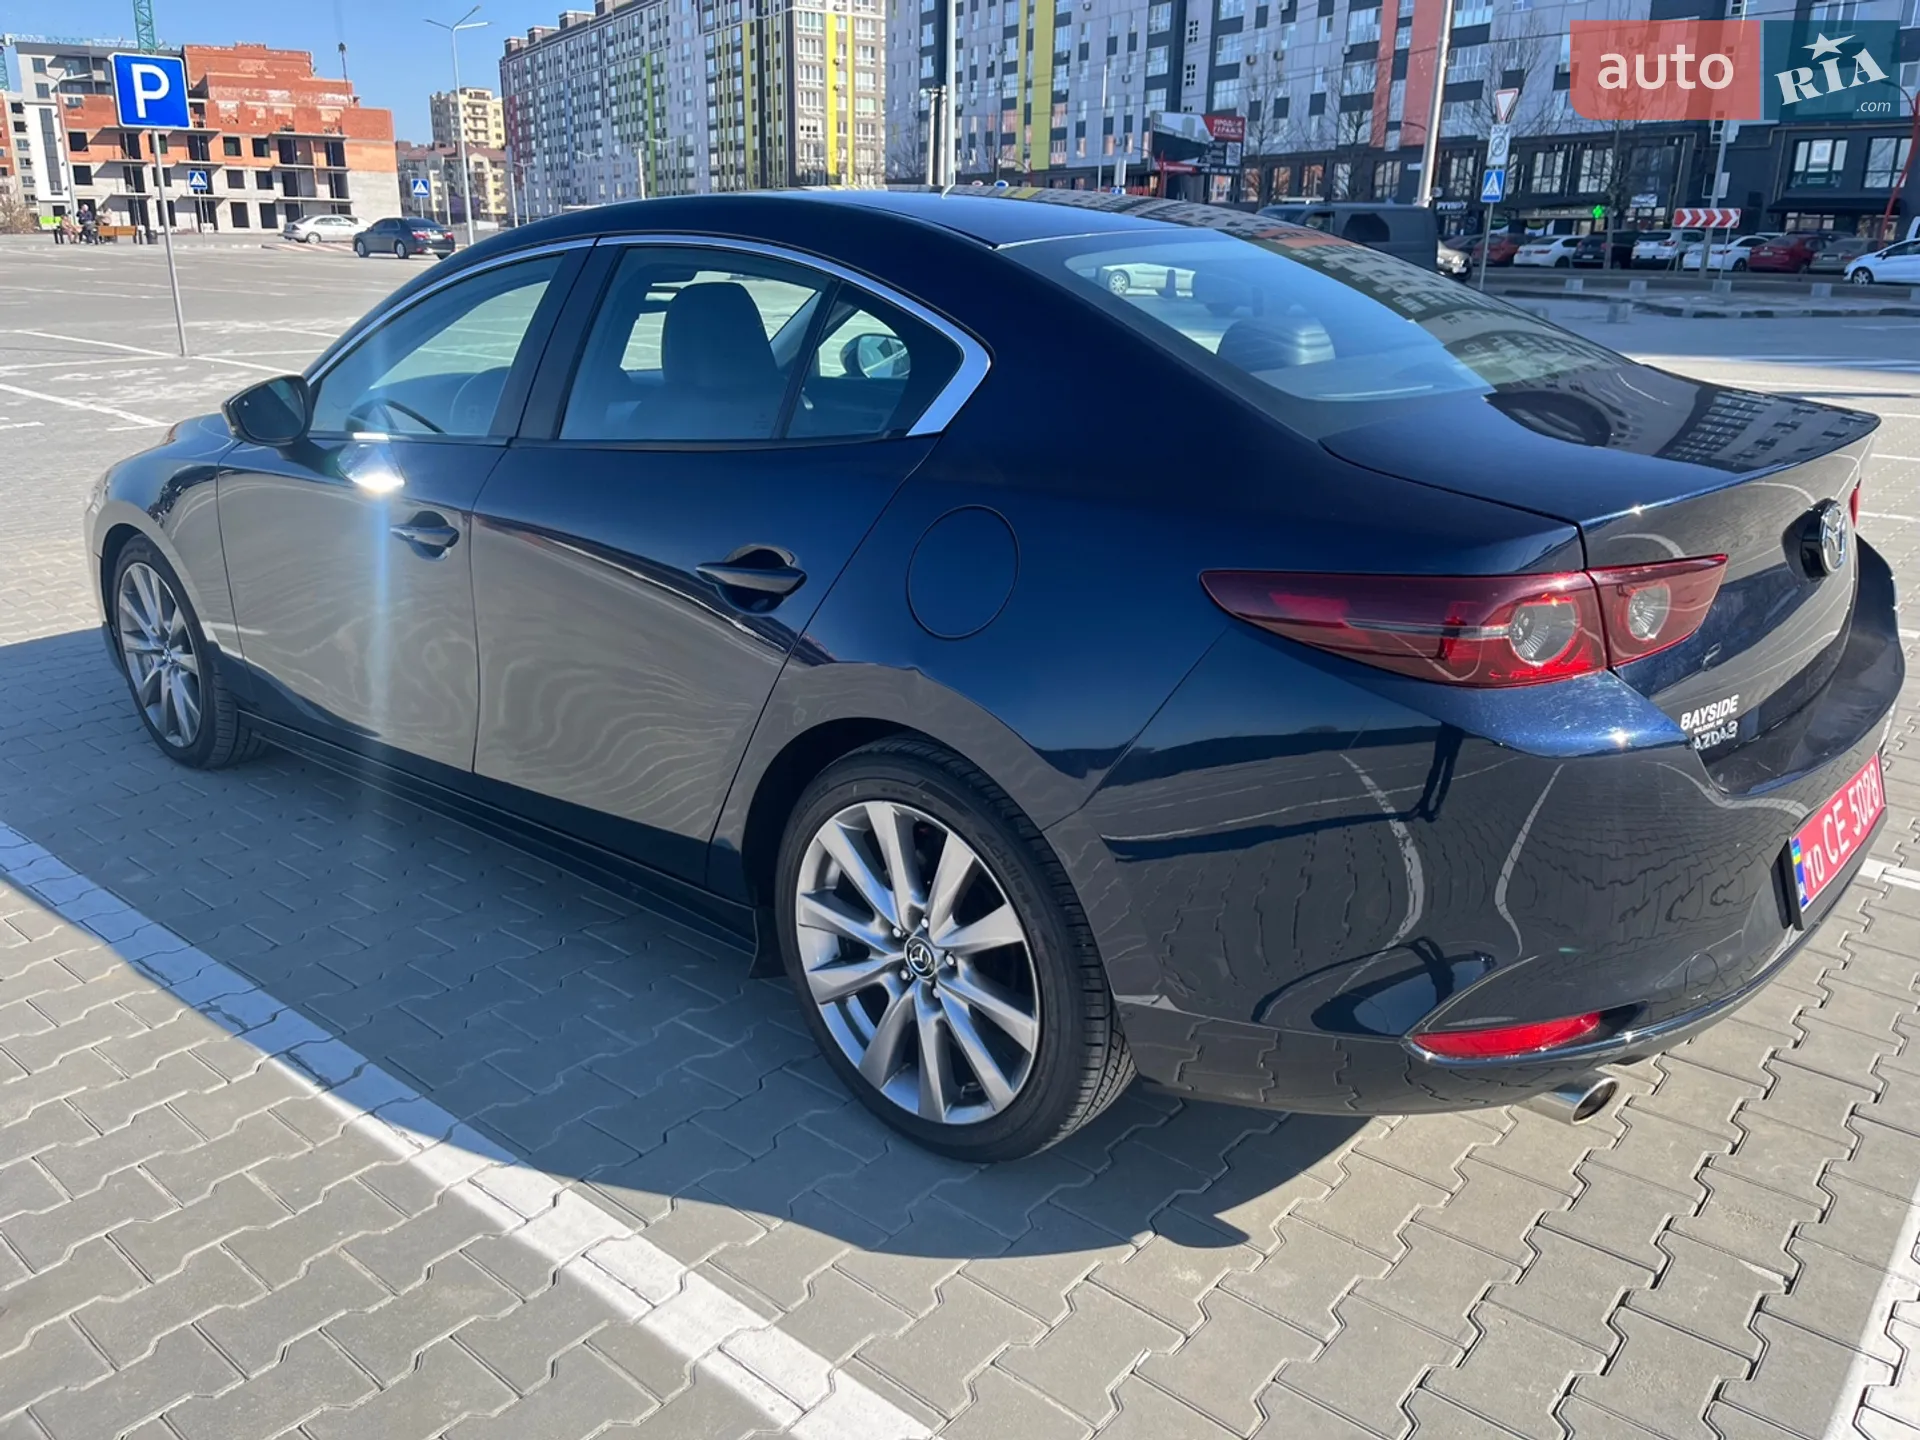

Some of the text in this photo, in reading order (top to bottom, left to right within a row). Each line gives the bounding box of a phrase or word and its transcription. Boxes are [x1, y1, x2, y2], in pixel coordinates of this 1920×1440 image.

[131, 63, 170, 118] P
[1680, 694, 1739, 731] BAYSIDE
[1694, 720, 1738, 750] AZDA3
[1805, 762, 1880, 889] 10 CE 5028
